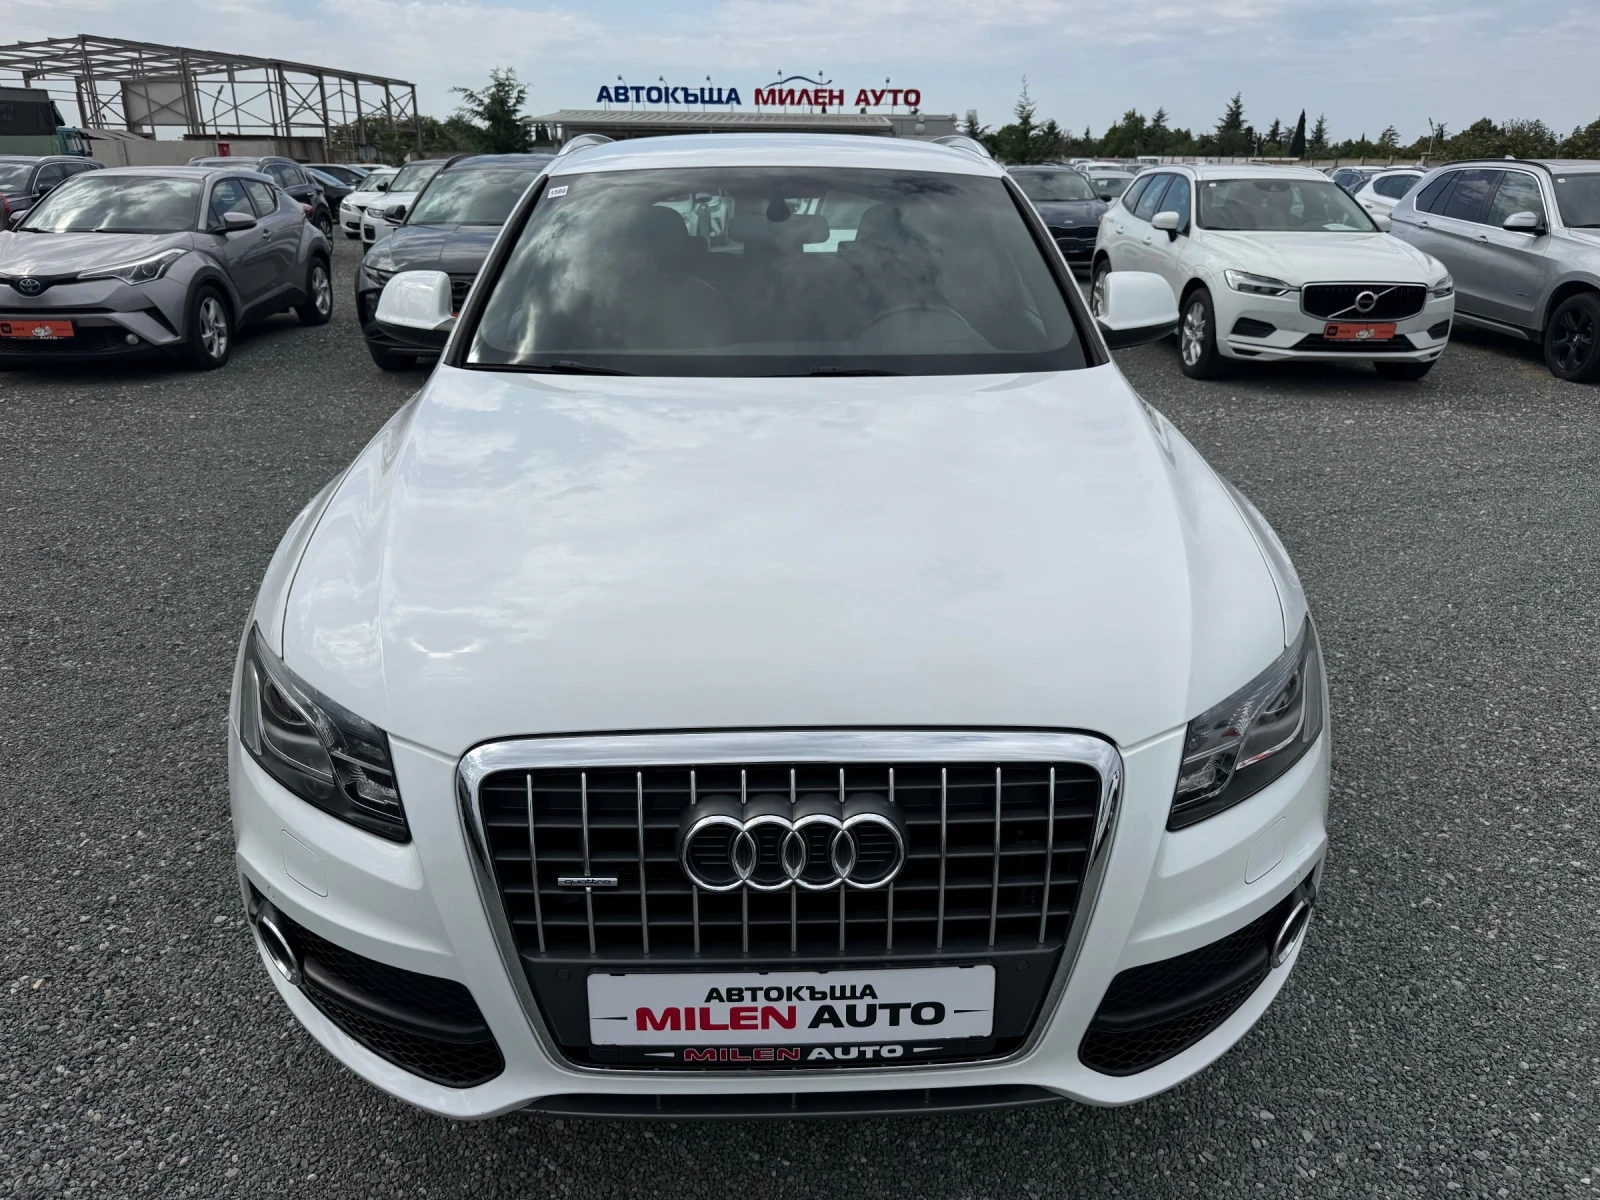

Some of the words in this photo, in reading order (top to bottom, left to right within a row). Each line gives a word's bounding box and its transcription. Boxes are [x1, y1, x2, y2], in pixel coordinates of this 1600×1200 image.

[596, 85, 741, 105] АВТОКЪЩА
[754, 88, 845, 107] МИЛЕН
[854, 89, 921, 107] АУТО
[564, 878, 612, 886] quattro
[704, 984, 878, 1003] АВТОКЪЩА
[635, 1005, 797, 1032] MILEN
[807, 1001, 946, 1029] AUTO
[683, 1047, 801, 1062] MILEN
[806, 1044, 905, 1061] AUTO
